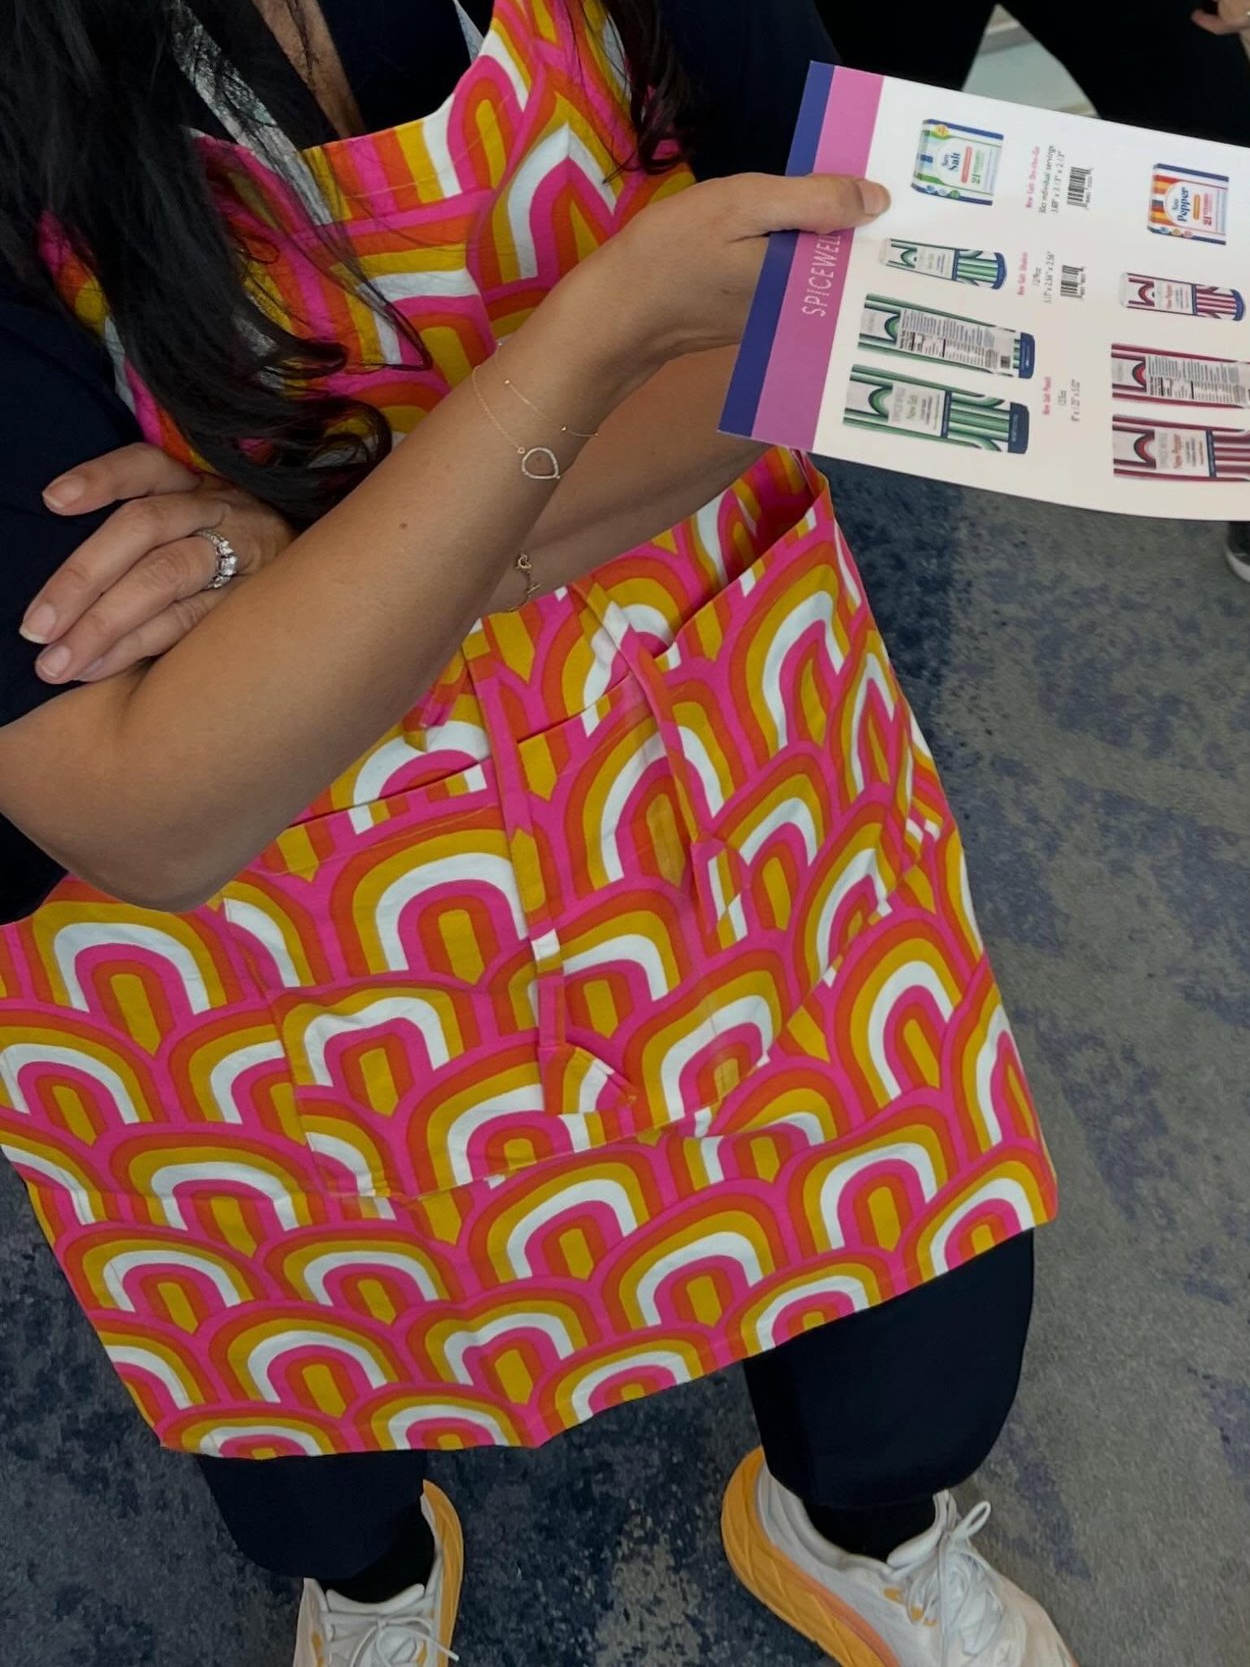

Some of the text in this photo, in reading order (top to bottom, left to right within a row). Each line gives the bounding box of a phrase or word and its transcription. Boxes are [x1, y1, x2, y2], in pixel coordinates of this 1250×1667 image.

[949, 152, 960, 171] Salt
[1177, 187, 1190, 222] Pepper
[1203, 216, 1212, 226] 21
